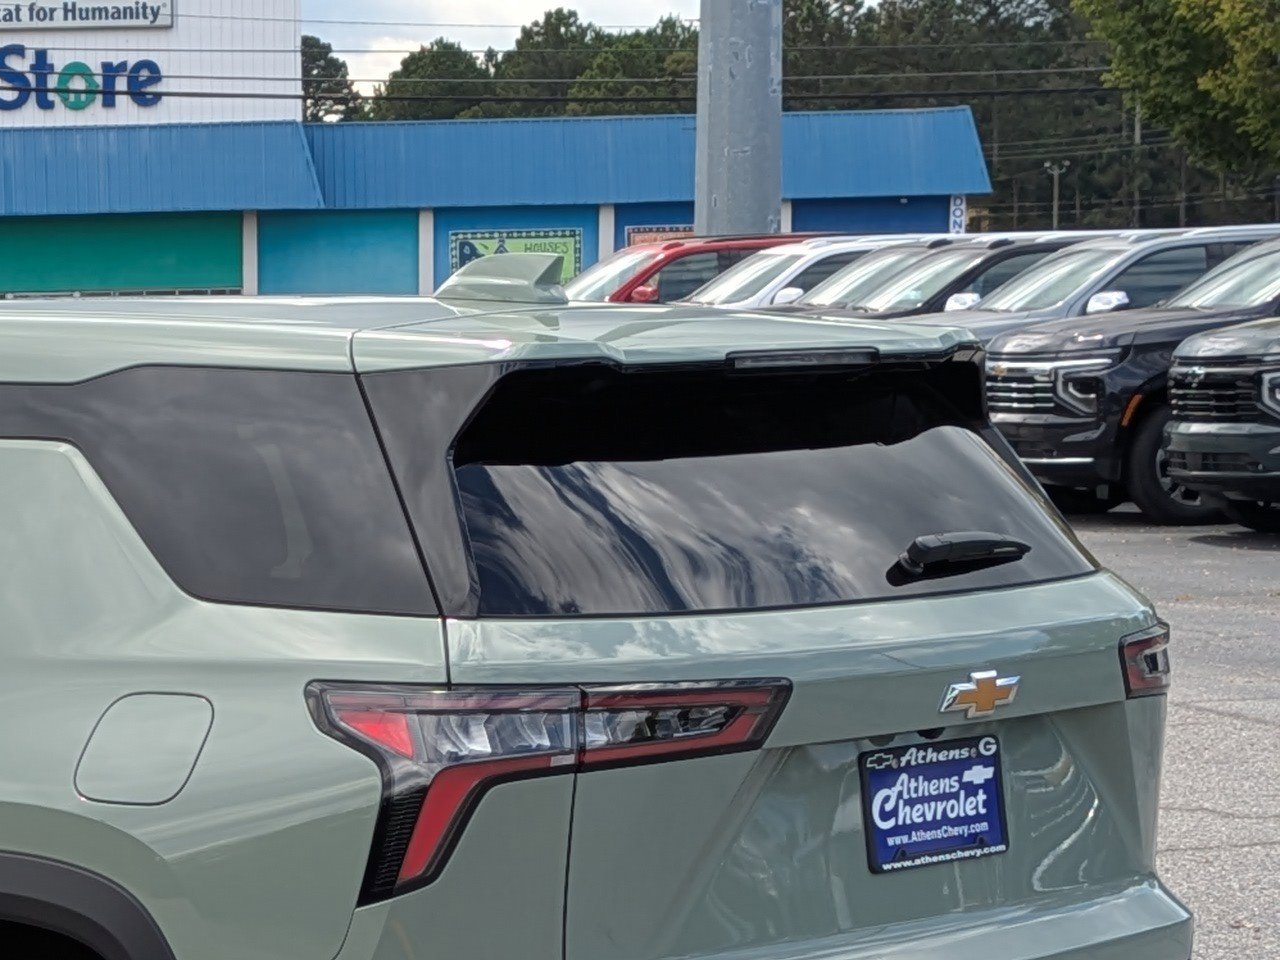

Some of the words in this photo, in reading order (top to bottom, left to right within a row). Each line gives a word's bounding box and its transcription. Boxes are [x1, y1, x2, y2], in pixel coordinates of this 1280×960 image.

[28, 3, 58, 22] for
[61, 1, 161, 25] Humanity
[952, 196, 964, 234] DON
[900, 747, 970, 767] Athens
[978, 736, 998, 757] G
[889, 772, 960, 802] Athens
[871, 787, 988, 831] Chevrolet
[886, 821, 990, 847] www.AthensChevy.com
[881, 844, 1007, 871] www.athenschevy.com
